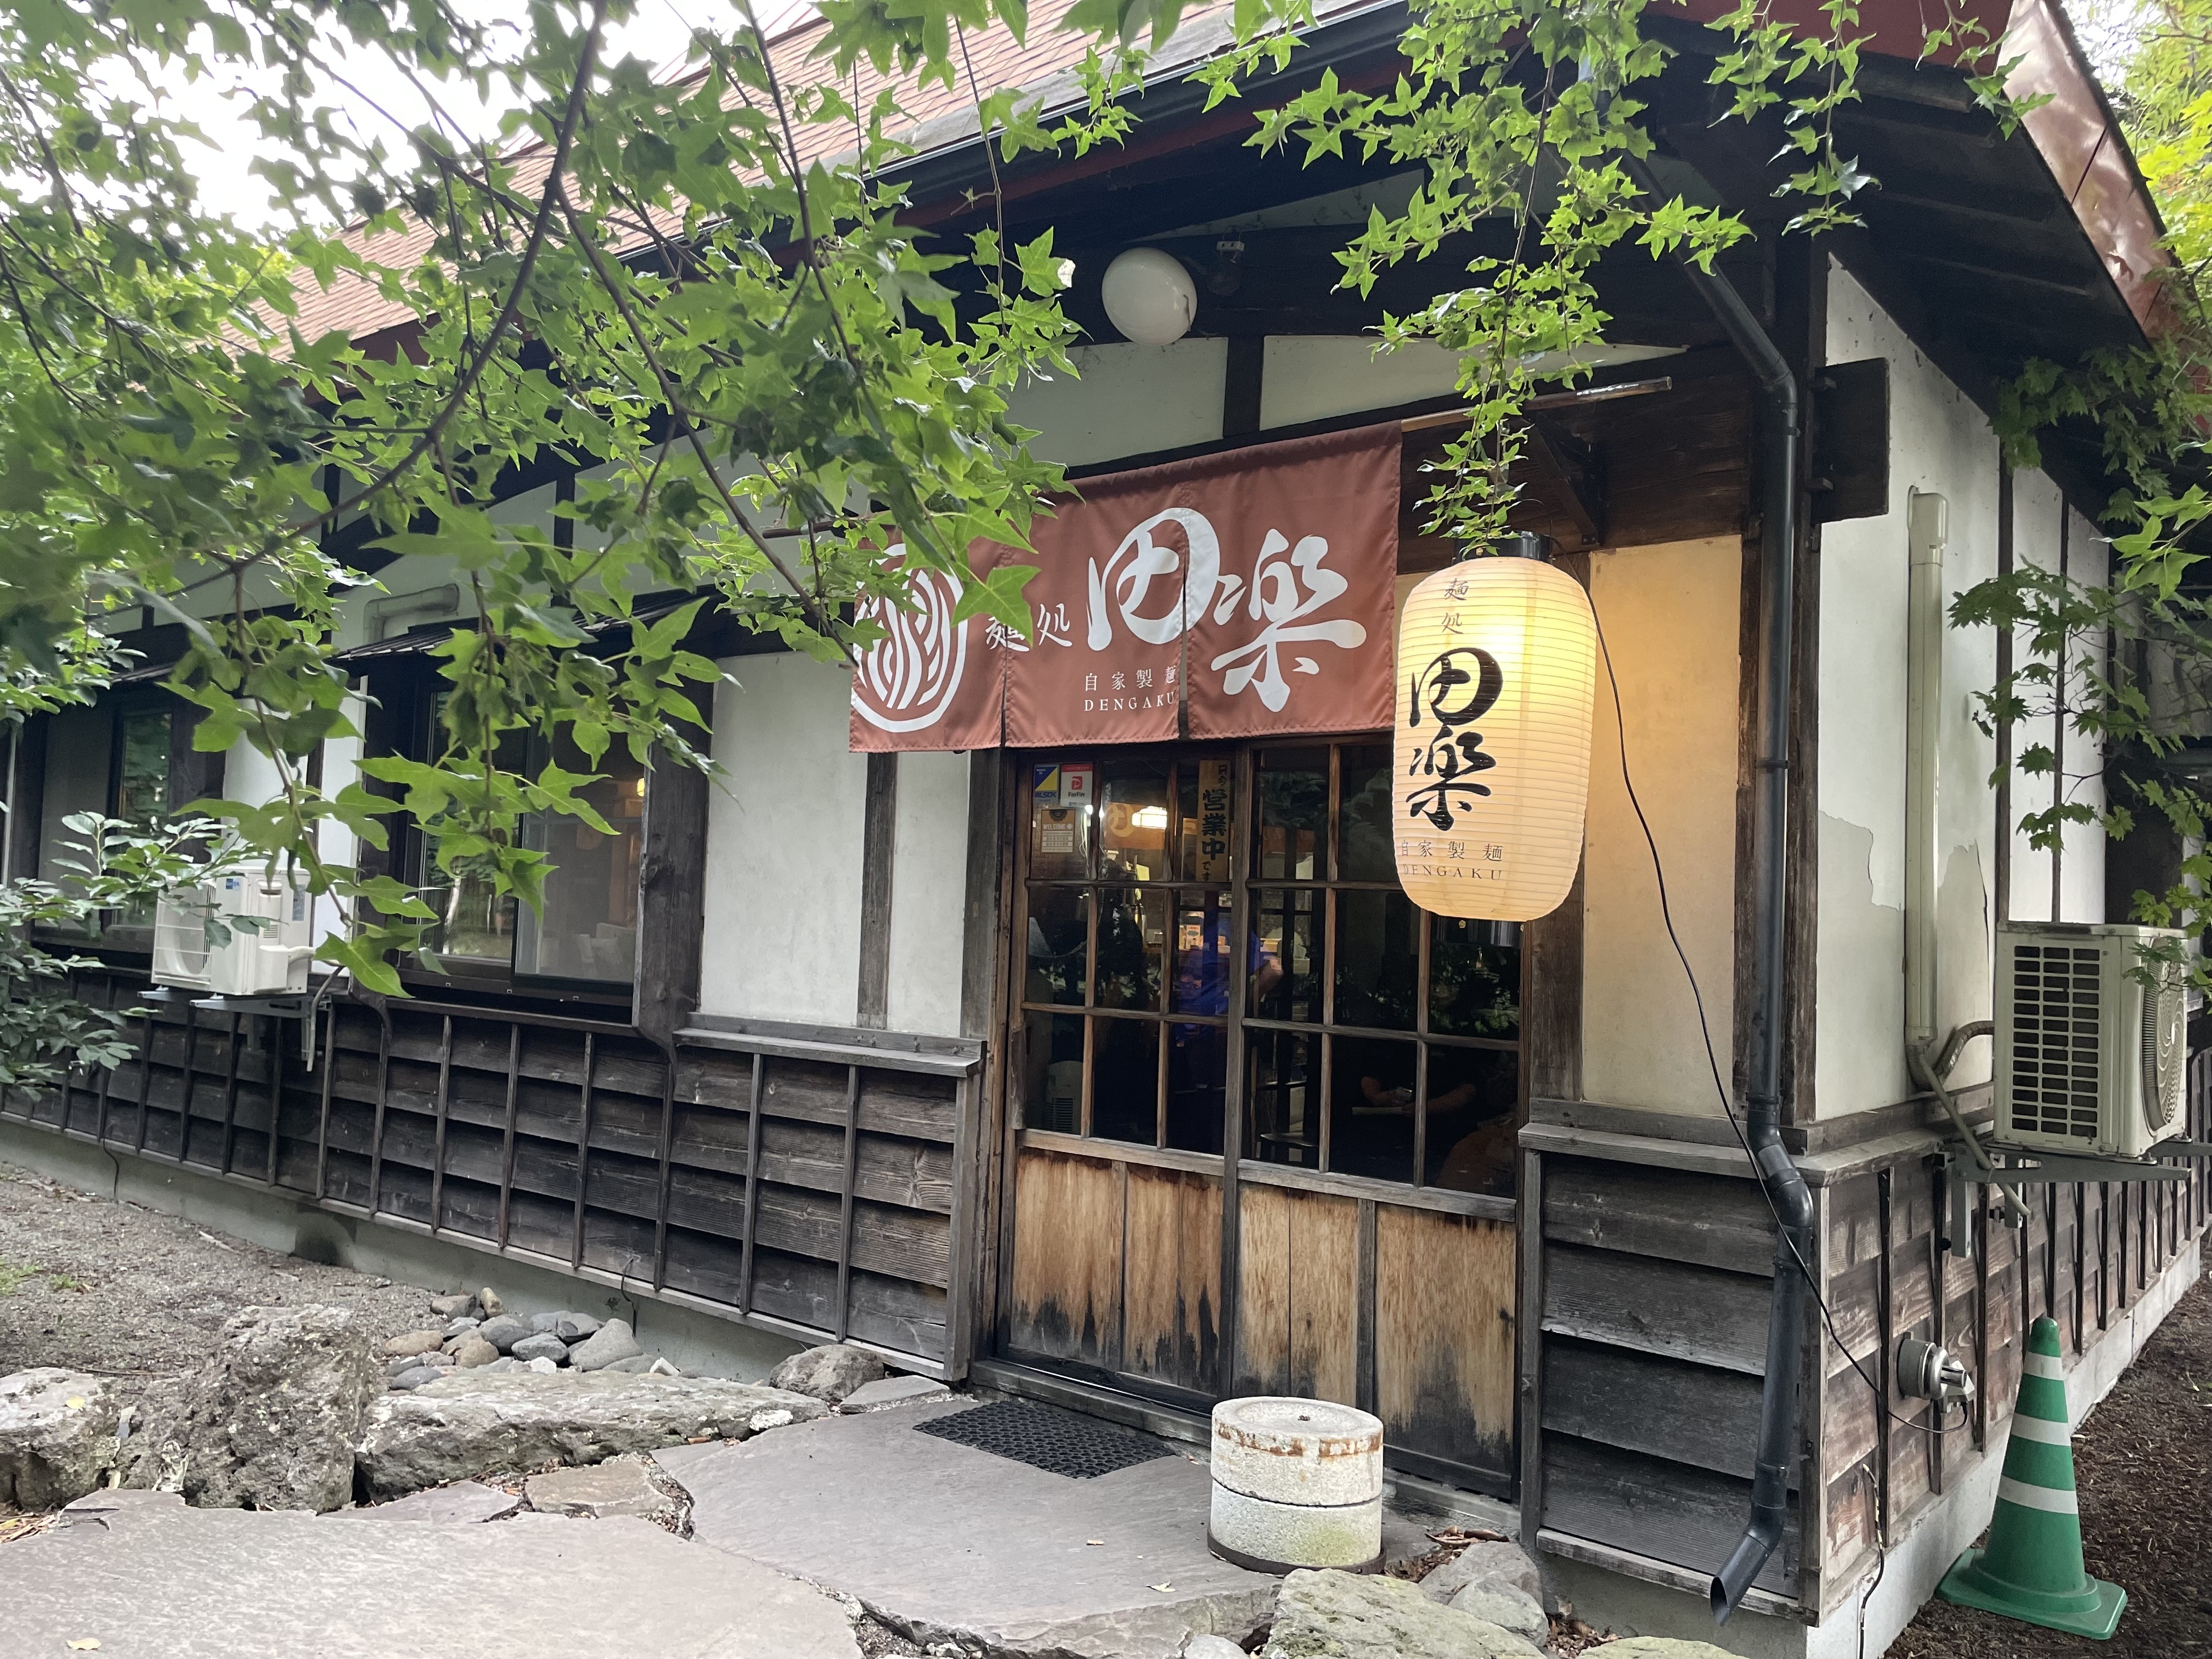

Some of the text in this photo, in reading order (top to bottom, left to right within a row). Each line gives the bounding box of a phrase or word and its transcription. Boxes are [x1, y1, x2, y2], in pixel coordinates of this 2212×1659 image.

[1085, 665, 1176, 692] 自家製麺
[1084, 691, 1175, 712] DENGAKU
[1402, 839, 1504, 862] 自家製麺
[1403, 864, 1502, 881] DENGAKU
